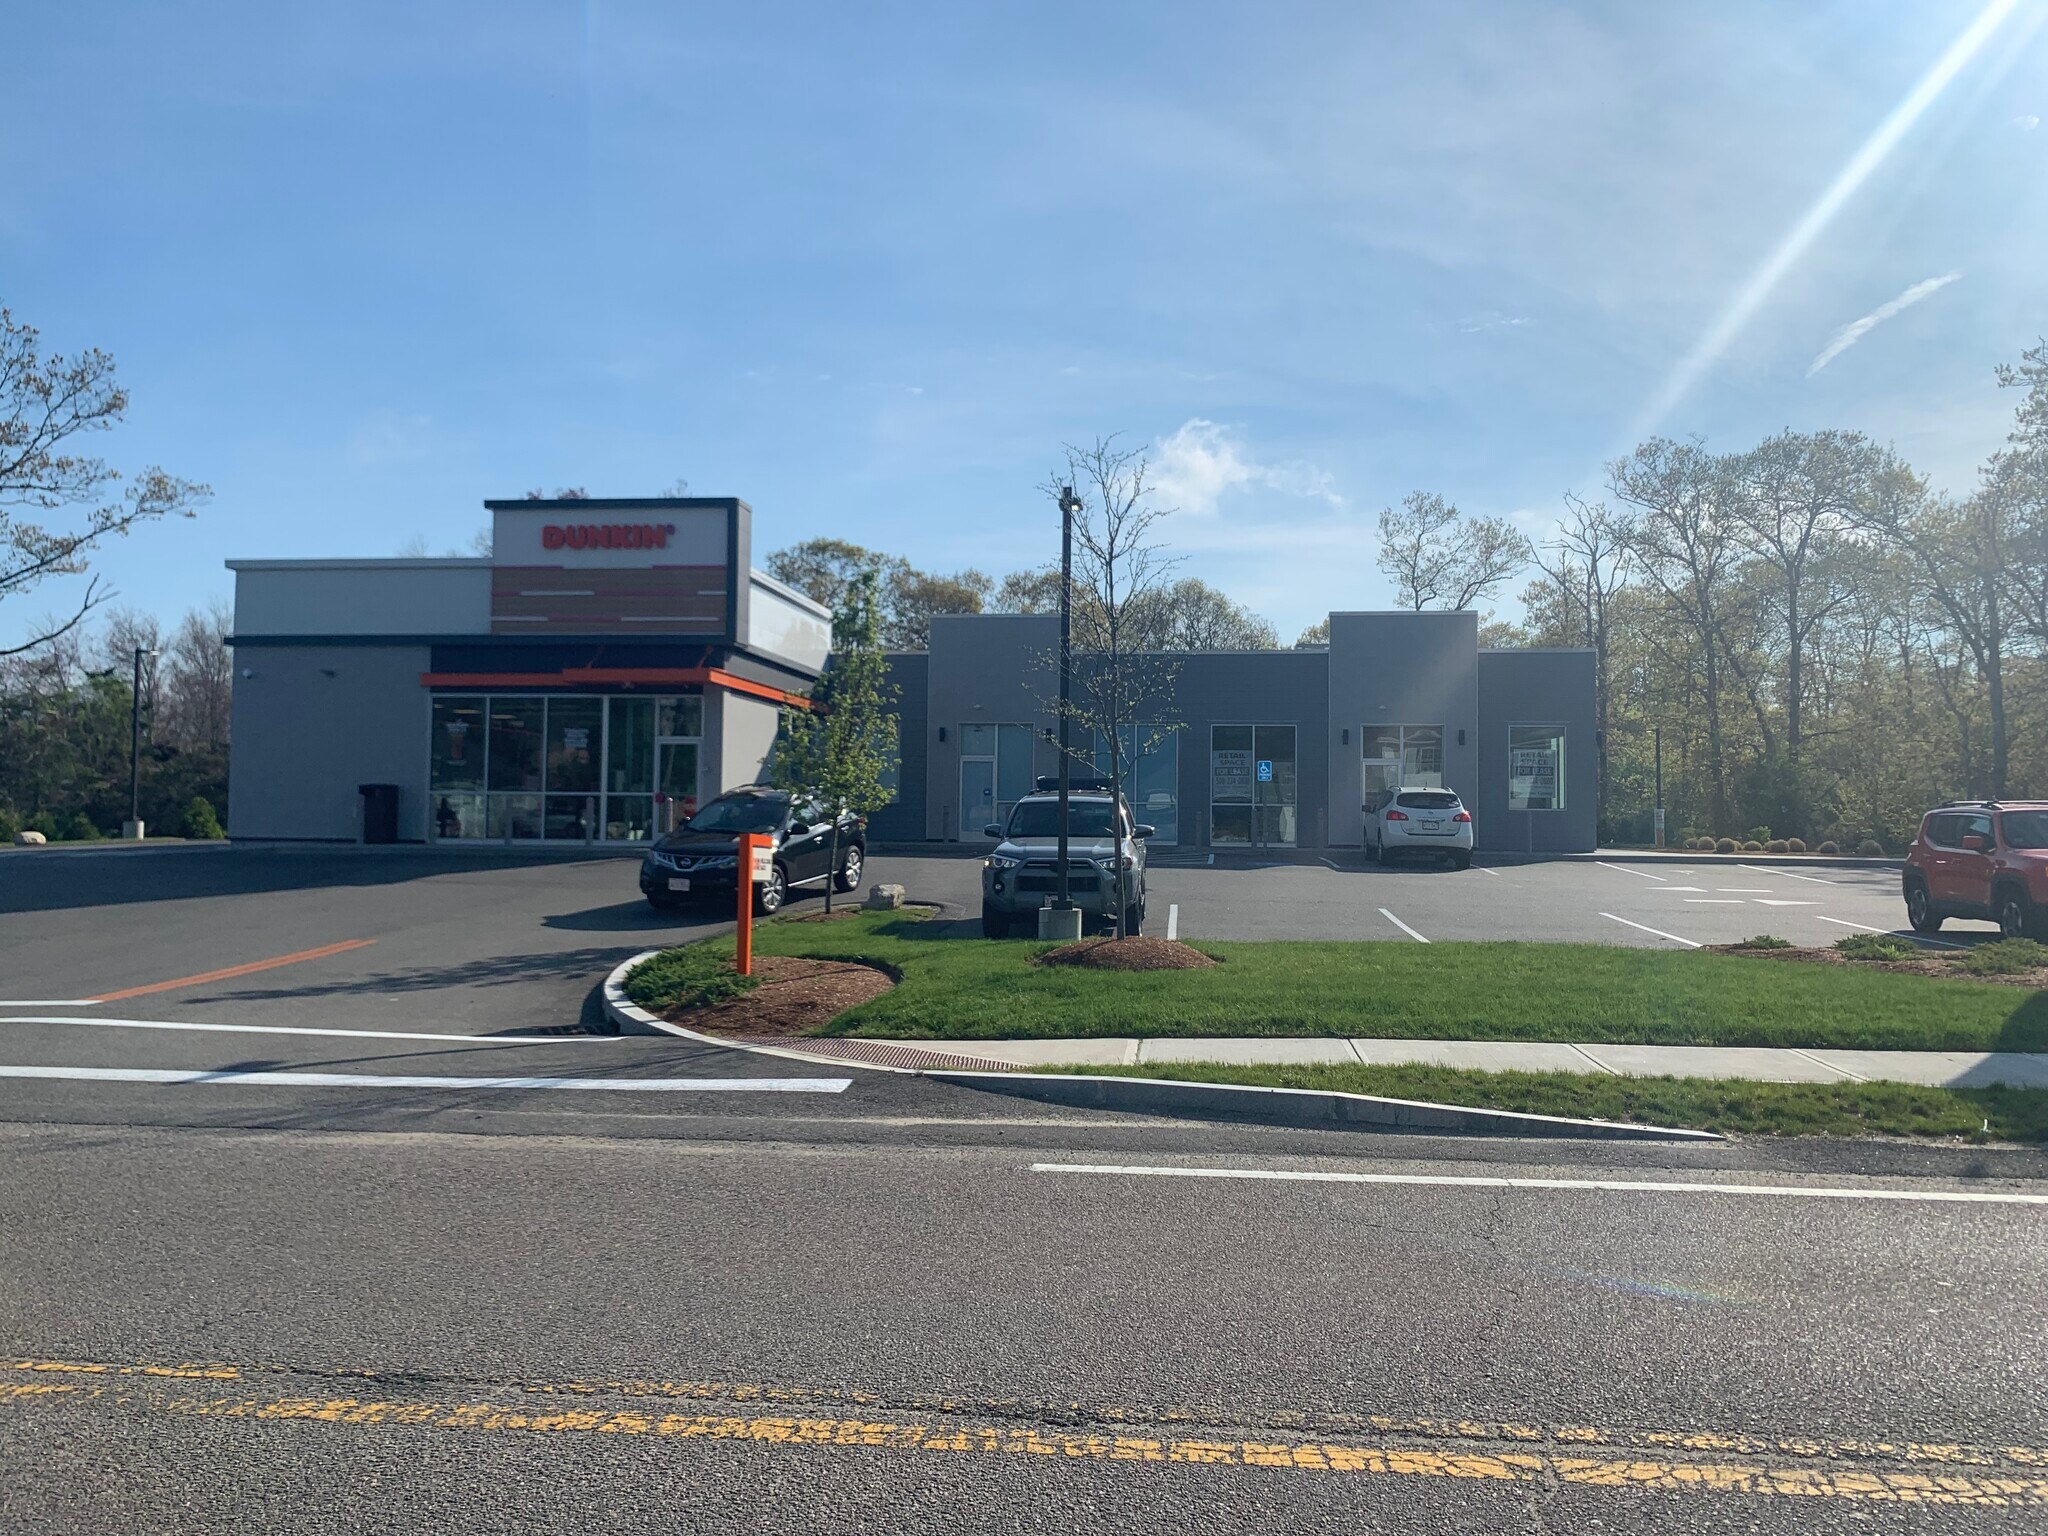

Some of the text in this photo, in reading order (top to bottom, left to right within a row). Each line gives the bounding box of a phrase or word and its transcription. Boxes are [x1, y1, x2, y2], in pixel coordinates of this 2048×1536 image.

[1520, 751, 1551, 759] RETAIL
[1519, 758, 1550, 766] SPACE
[1532, 767, 1552, 775] LEASE
